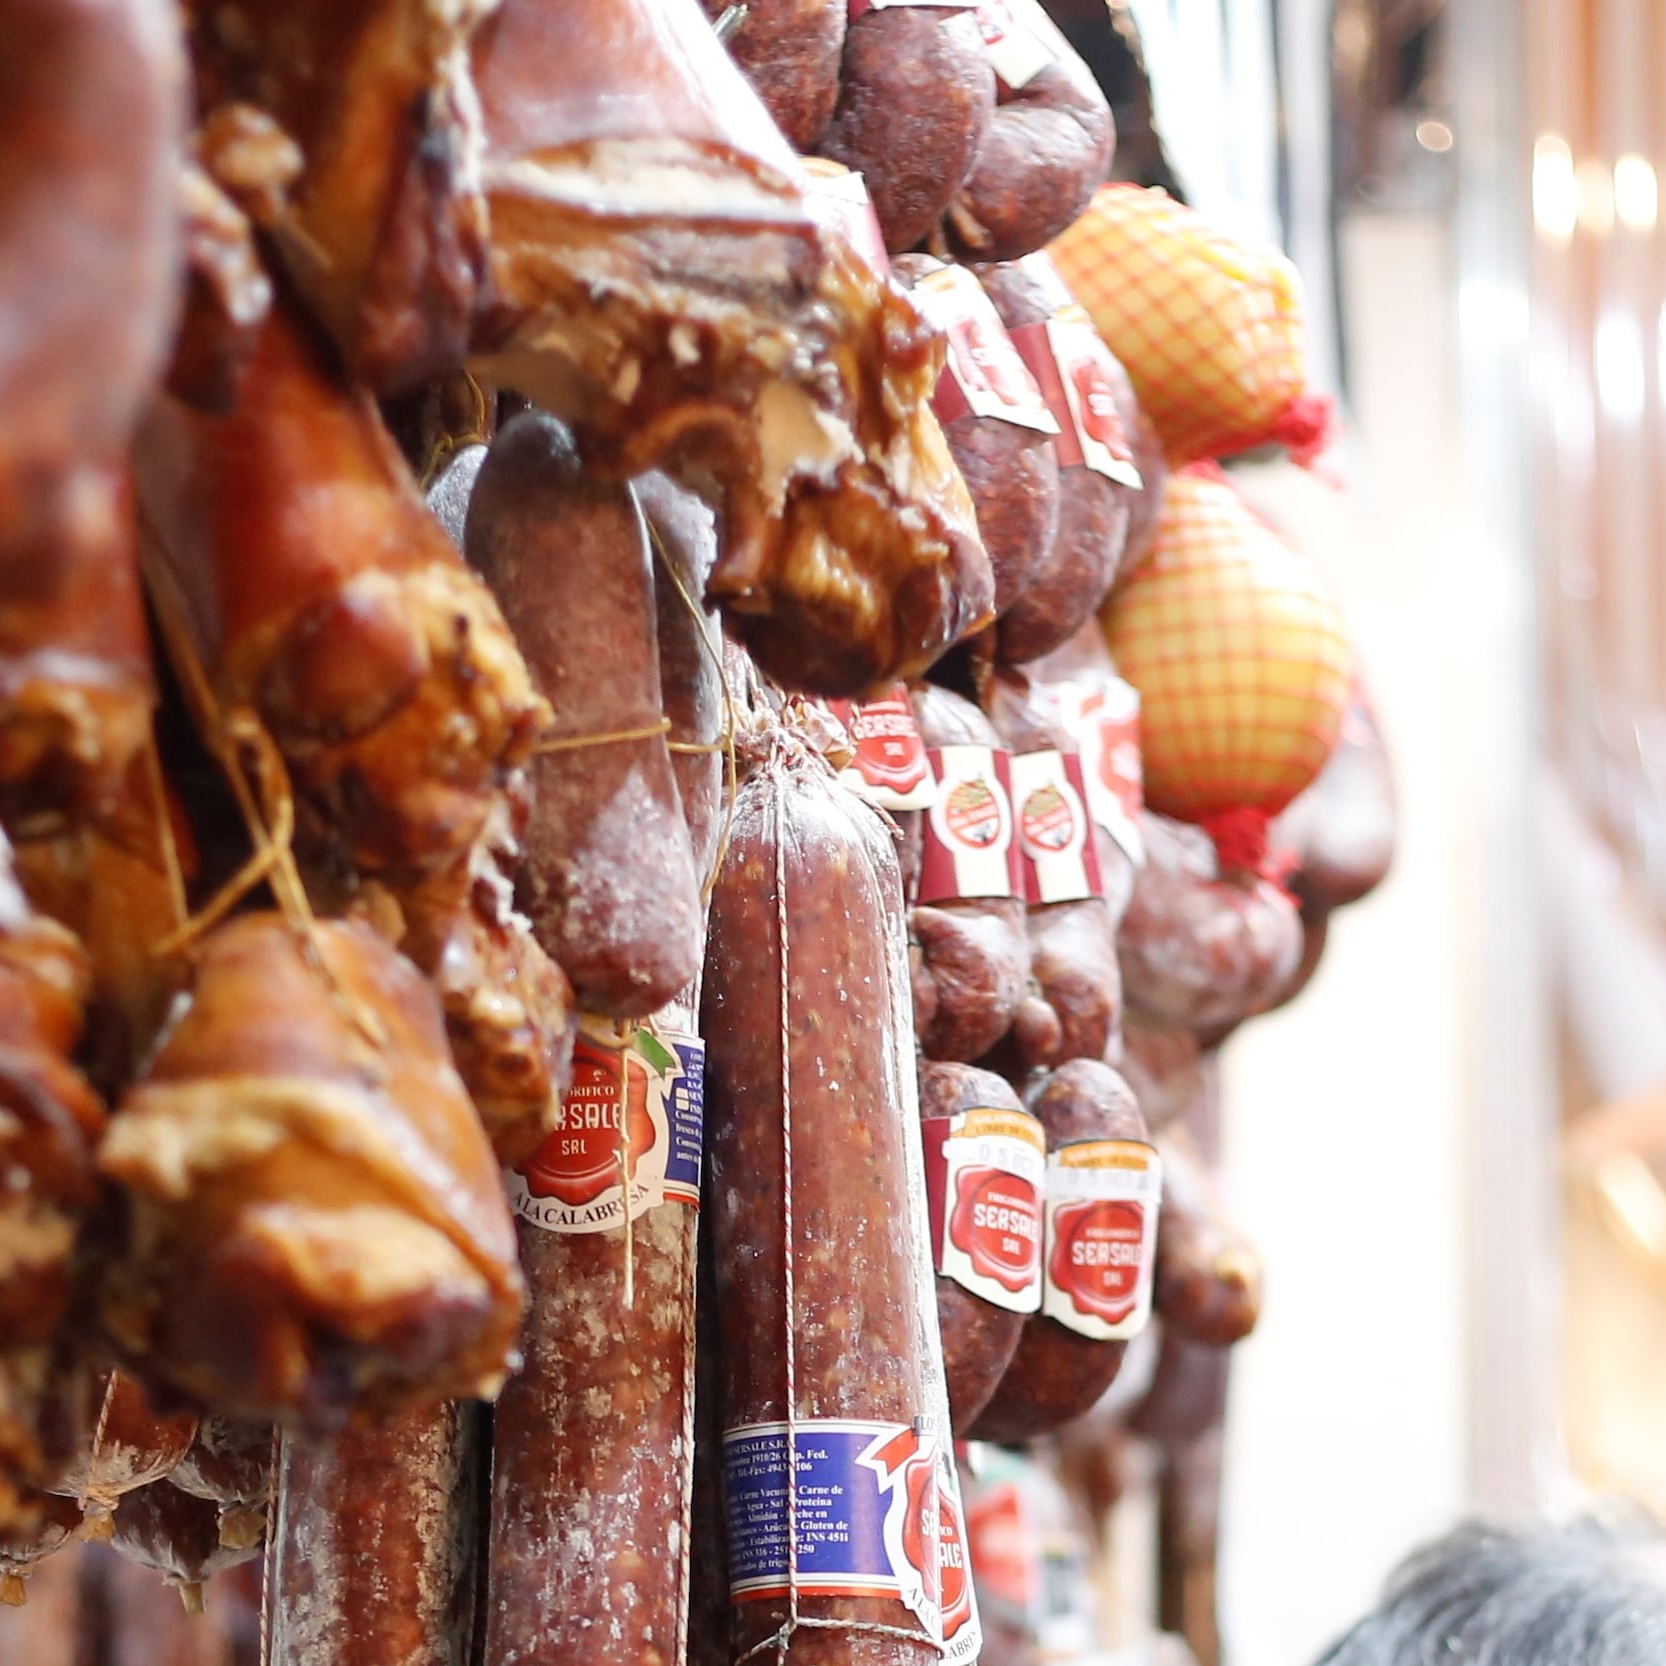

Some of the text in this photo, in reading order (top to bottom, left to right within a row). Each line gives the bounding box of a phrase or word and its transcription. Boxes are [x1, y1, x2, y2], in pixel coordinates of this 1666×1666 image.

[561, 1139, 588, 1156] SRL
[973, 1202, 1039, 1244] SERSALE
[1071, 1240, 1143, 1268] SERSALE
[806, 1449, 829, 1460] Fed.
[798, 1485, 829, 1496] Carne
[830, 1485, 844, 1495] de
[815, 1510, 828, 1519] en
[800, 1520, 835, 1531] Gluten
[835, 1520, 849, 1531] de
[806, 1532, 826, 1543] INS
[797, 1544, 815, 1555] 250
